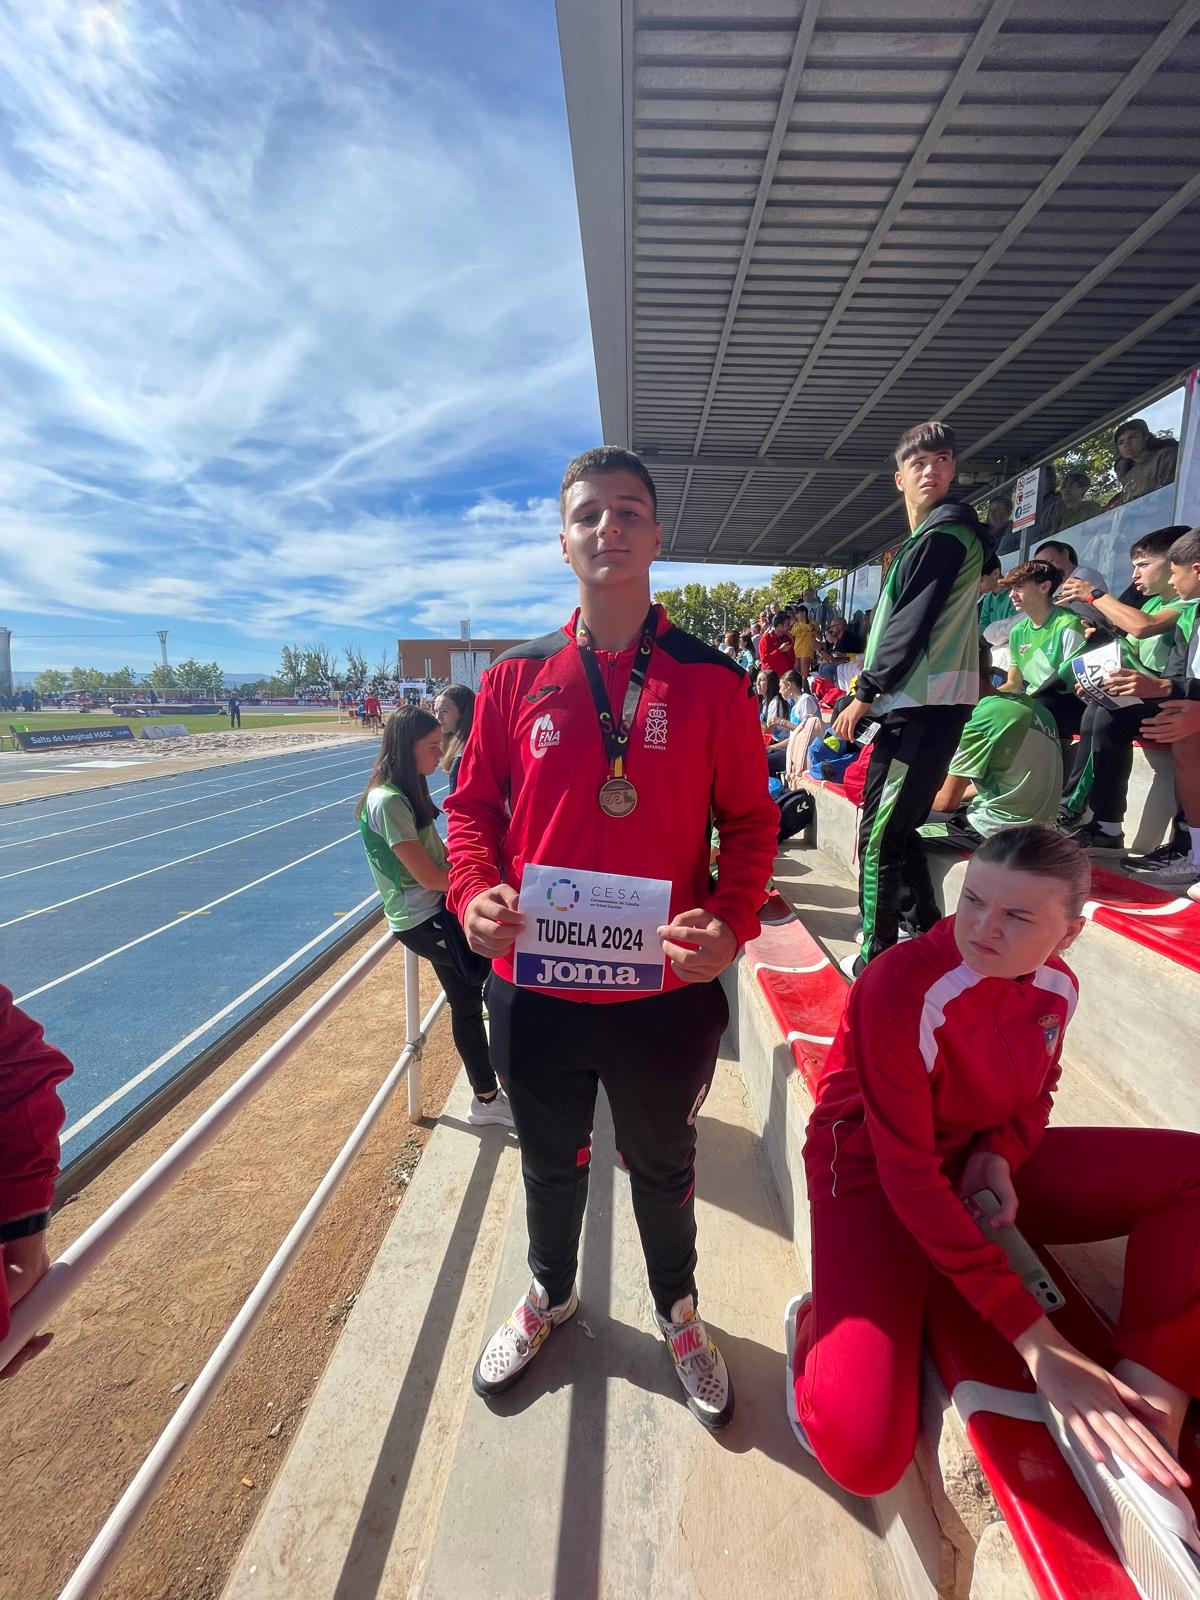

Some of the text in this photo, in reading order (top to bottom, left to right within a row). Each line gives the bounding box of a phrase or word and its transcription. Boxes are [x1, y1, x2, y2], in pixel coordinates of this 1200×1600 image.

[30, 736, 51, 744] Salto
[63, 733, 94, 742] Longitud
[94, 730, 113, 739] MASC
[539, 730, 560, 743] FNA
[591, 886, 640, 901] CESA
[536, 918, 644, 951] TUDELA 2024
[513, 1303, 543, 1336] NIKE
[673, 1326, 703, 1358] NIKE
